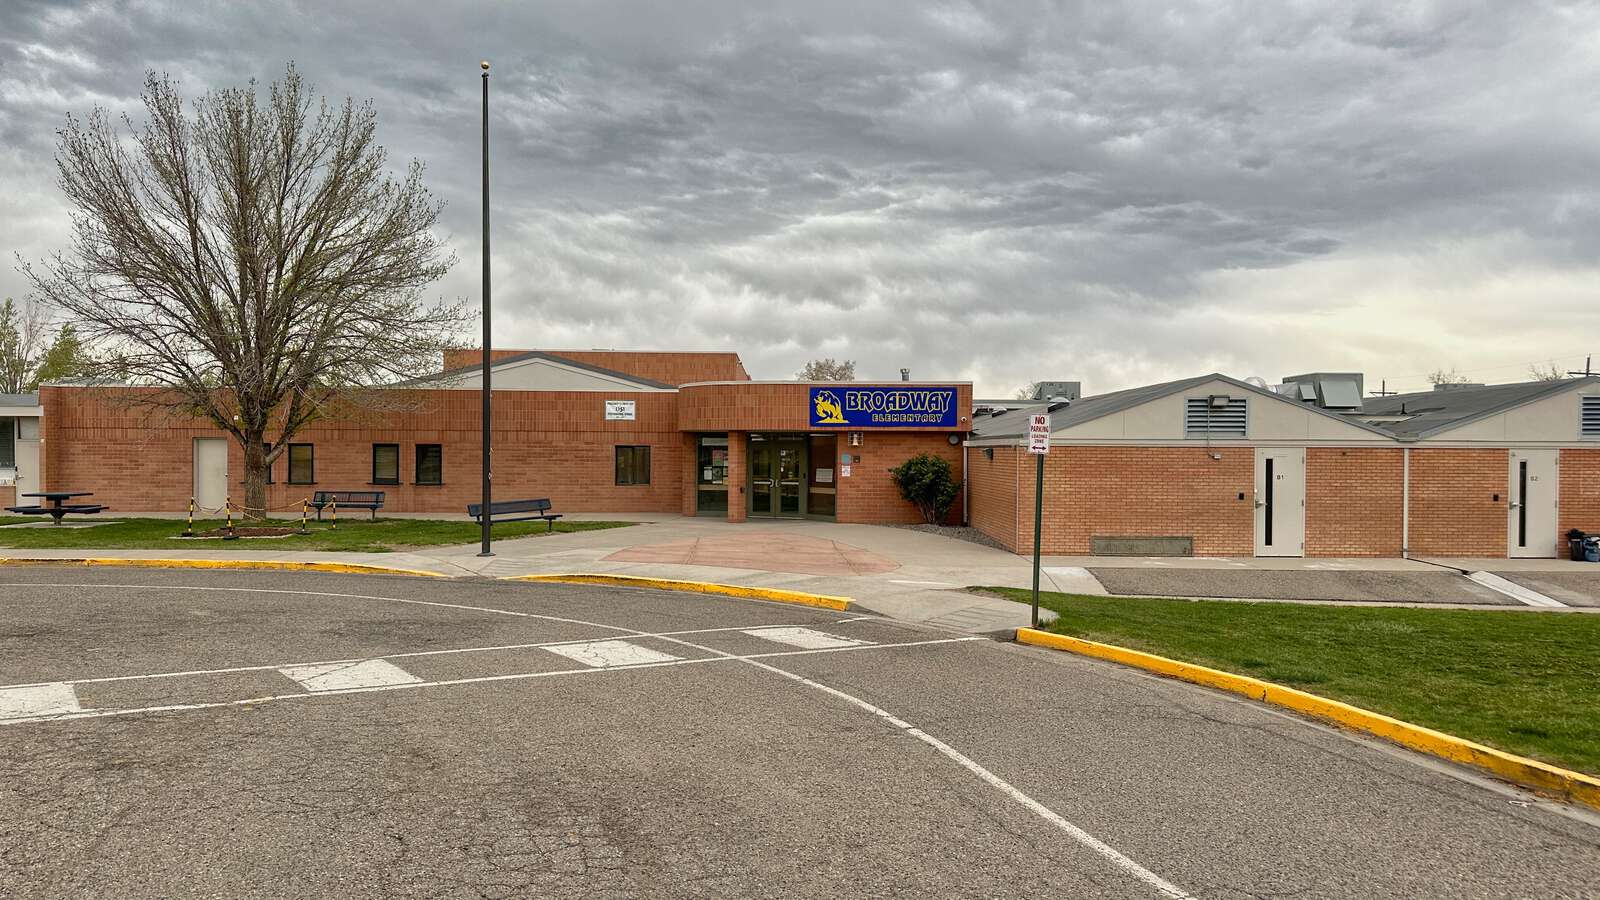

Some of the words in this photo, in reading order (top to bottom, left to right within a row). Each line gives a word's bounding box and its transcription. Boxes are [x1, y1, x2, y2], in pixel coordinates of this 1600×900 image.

[846, 391, 952, 413] BROADWAY
[872, 413, 943, 423] ELEMENTARY
[1034, 416, 1046, 425] NO
[1030, 425, 1049, 433] PARKING
